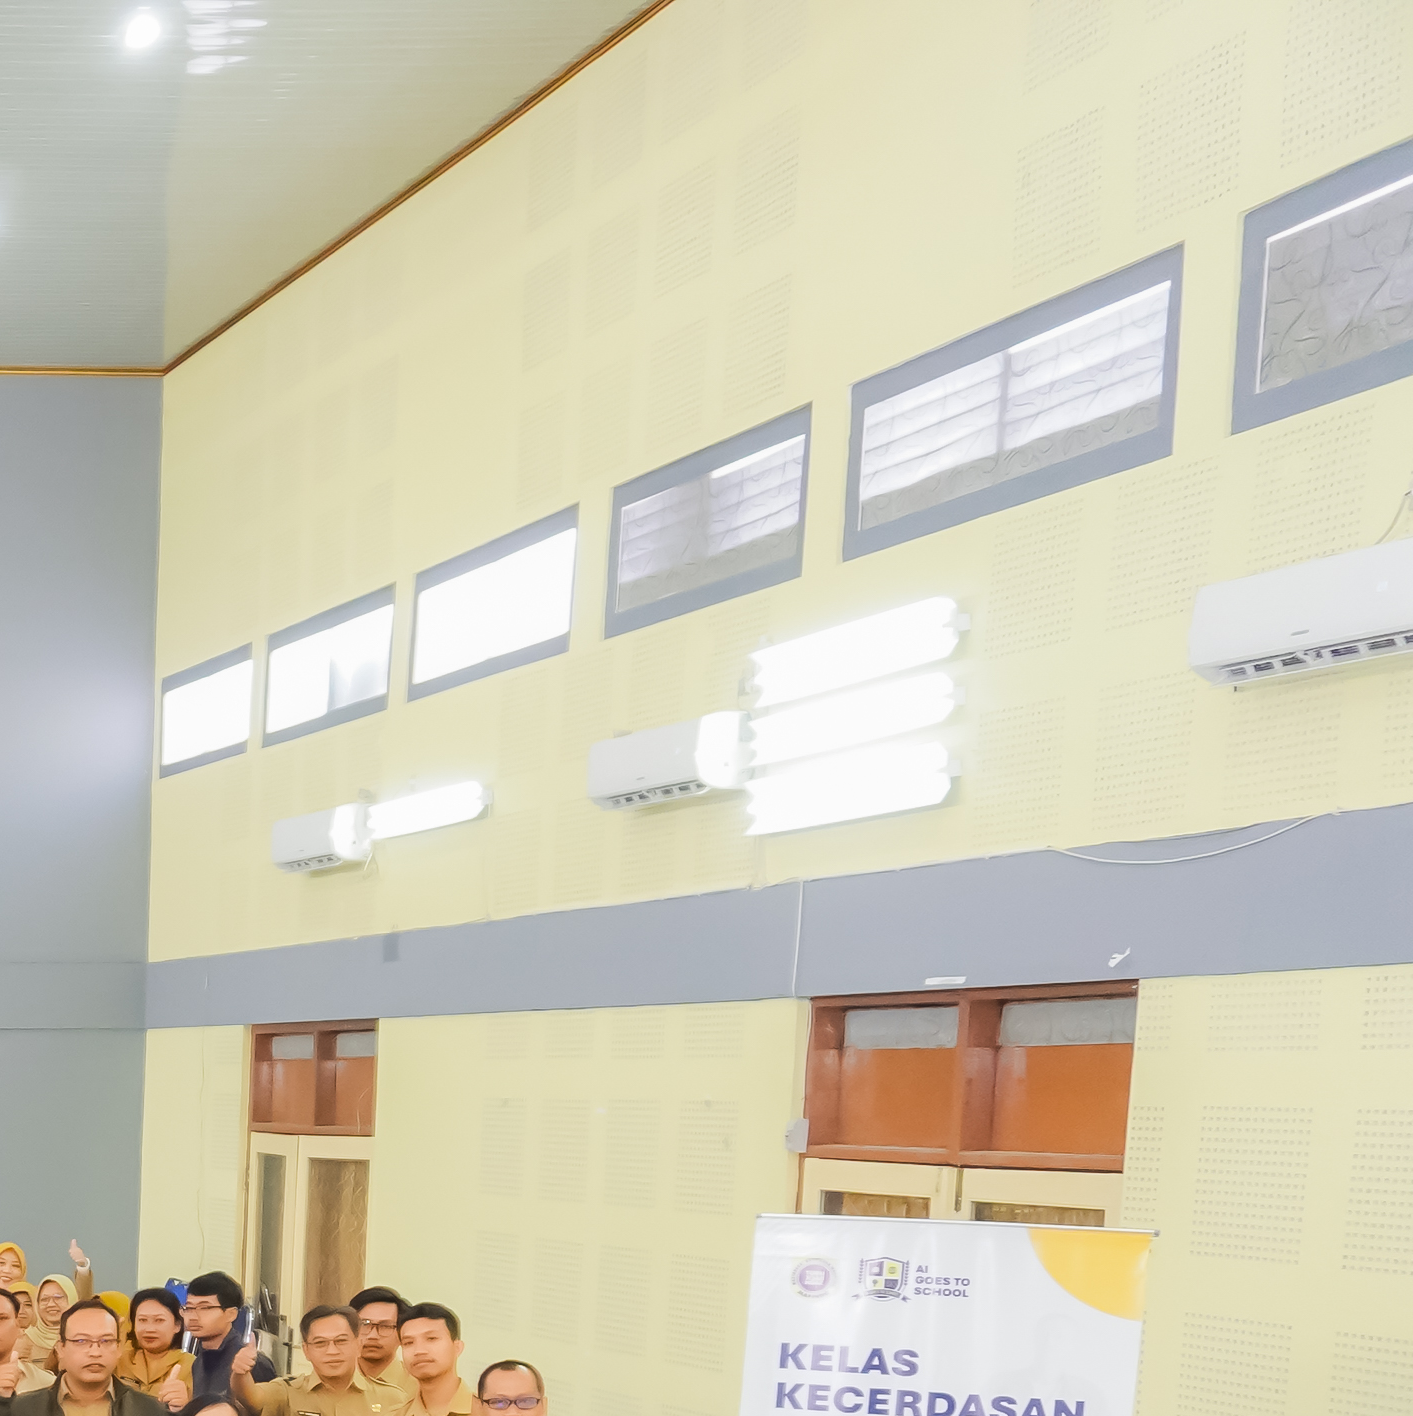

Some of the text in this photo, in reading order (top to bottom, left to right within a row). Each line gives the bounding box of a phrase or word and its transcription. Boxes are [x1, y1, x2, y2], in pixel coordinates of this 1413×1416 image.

[915, 1265, 929, 1274] AI
[915, 1275, 971, 1287] GOES TO
[913, 1286, 969, 1298] SCHOOL
[778, 1342, 920, 1377] KELAS
